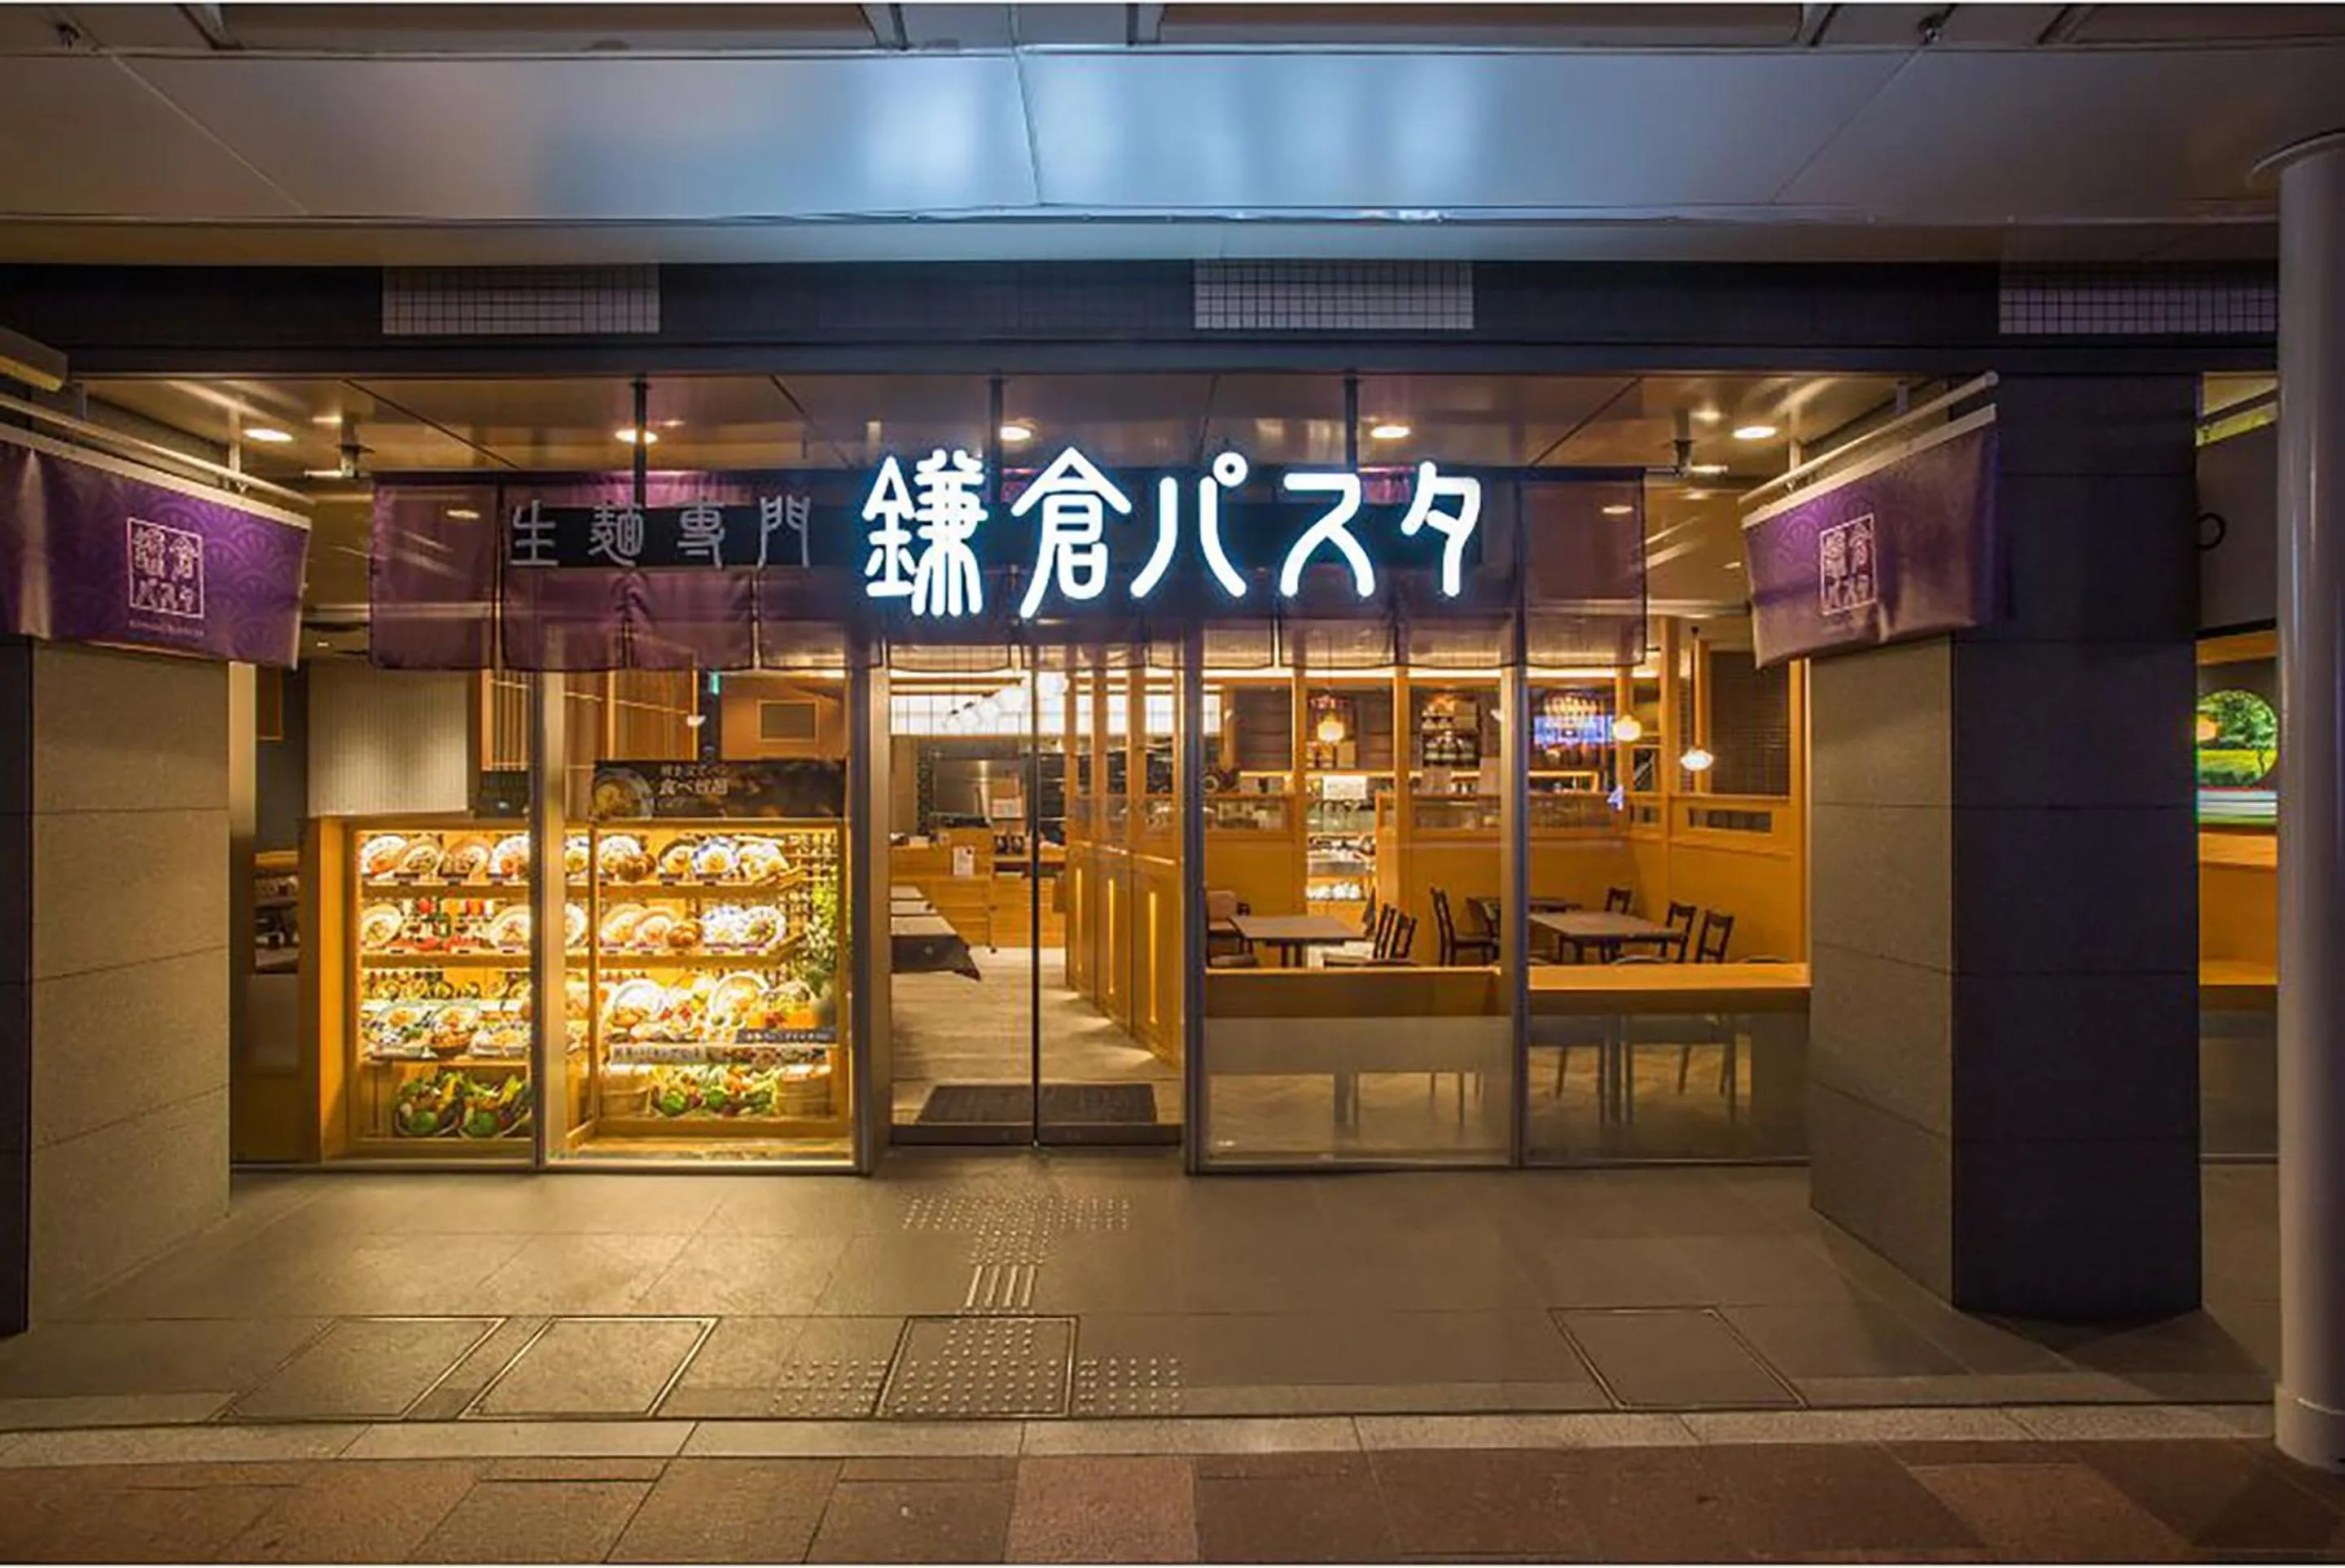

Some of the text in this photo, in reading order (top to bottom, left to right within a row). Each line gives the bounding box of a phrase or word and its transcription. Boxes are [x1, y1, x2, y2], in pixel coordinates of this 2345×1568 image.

[510, 446, 1481, 619] 生麺専門 鎌倉パスタ
